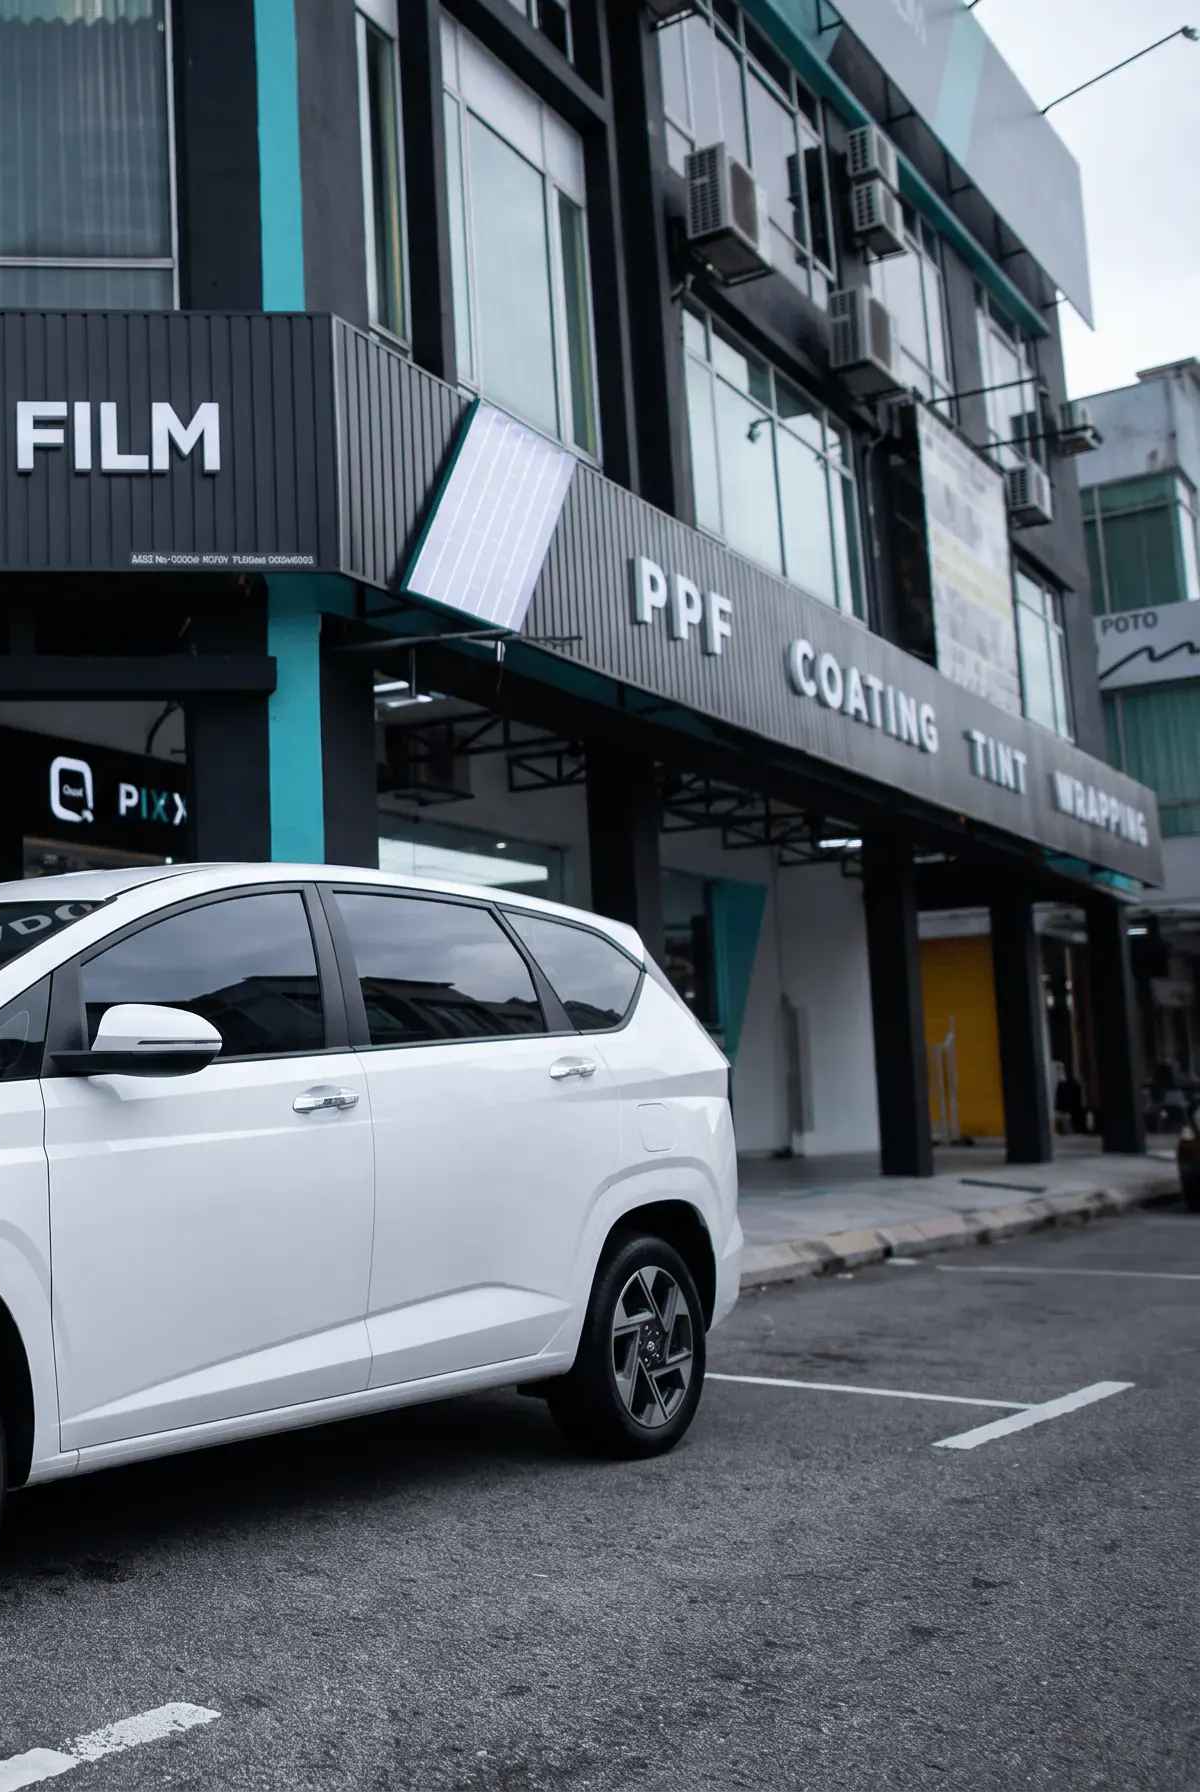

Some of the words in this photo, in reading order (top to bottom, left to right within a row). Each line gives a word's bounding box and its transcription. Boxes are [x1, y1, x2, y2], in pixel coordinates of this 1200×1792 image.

[16, 400, 221, 475] FILM
[636, 555, 732, 656] PPF
[1101, 611, 1159, 635] POTO
[788, 638, 939, 754] COATING
[968, 728, 1028, 795] TINT
[1053, 770, 1149, 848] WRAPPING
